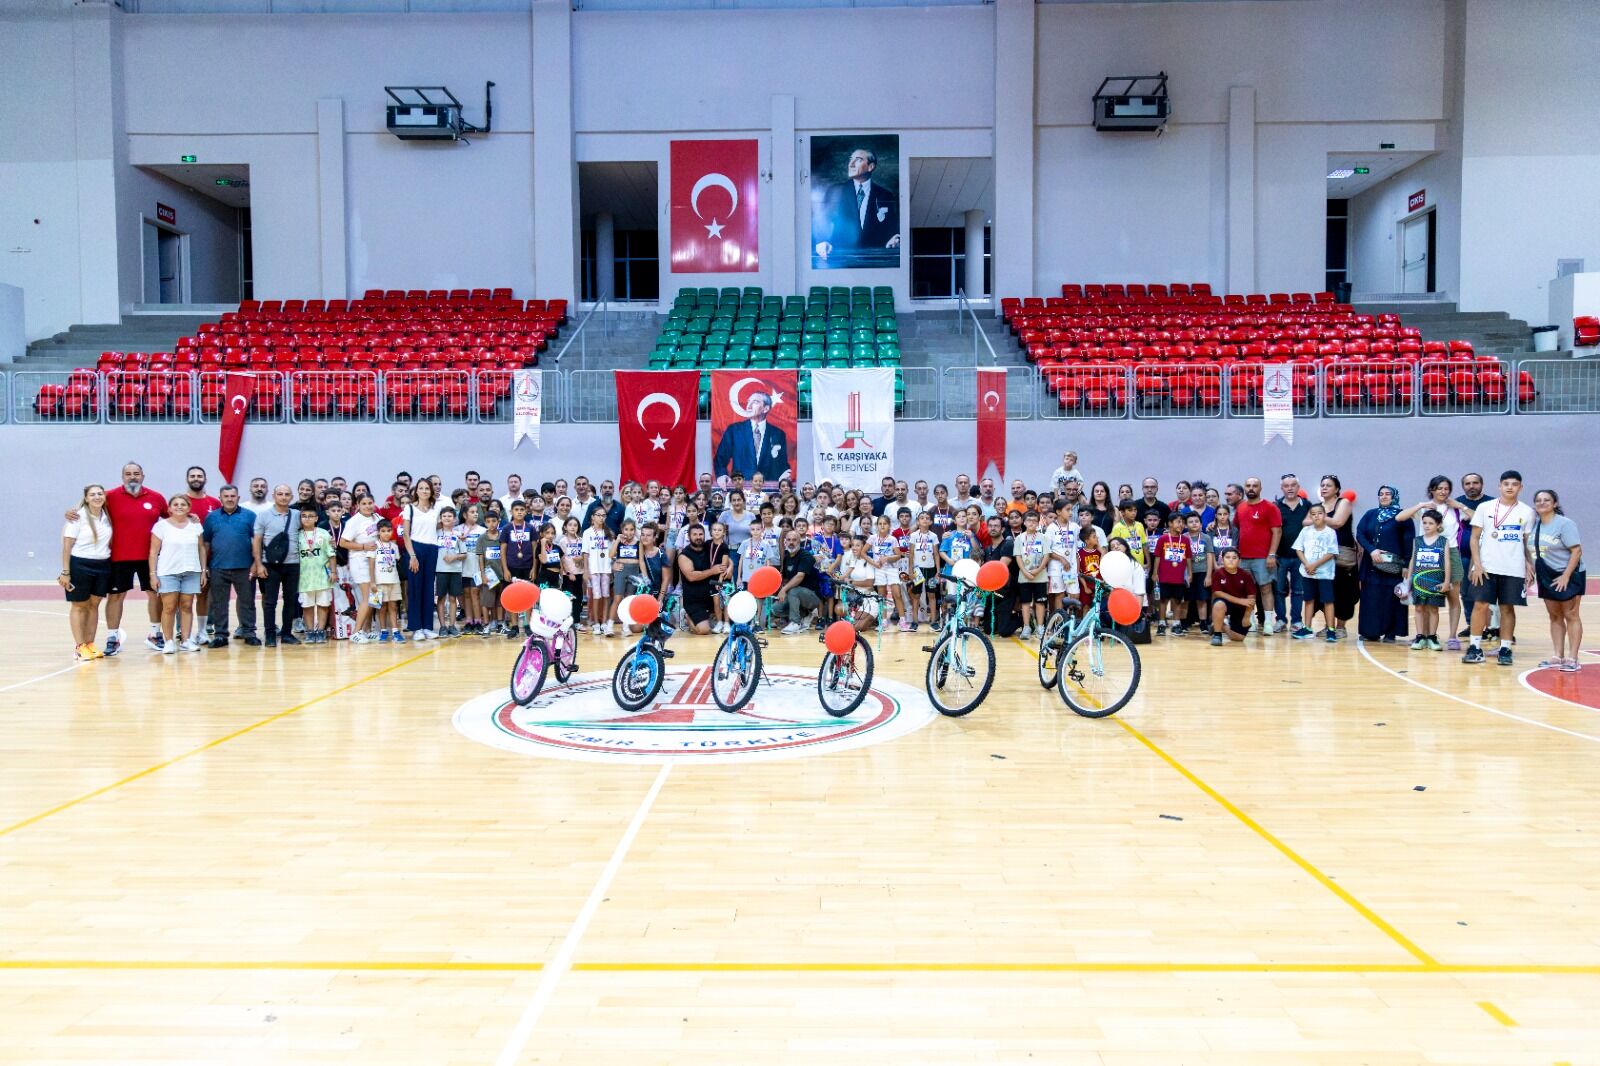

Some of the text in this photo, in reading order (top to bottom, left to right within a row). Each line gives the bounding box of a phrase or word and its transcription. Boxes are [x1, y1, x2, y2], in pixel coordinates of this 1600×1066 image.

[820, 451, 888, 463] T.C. KARŞIYAKA
[831, 462, 877, 472] BELEDİYESİ
